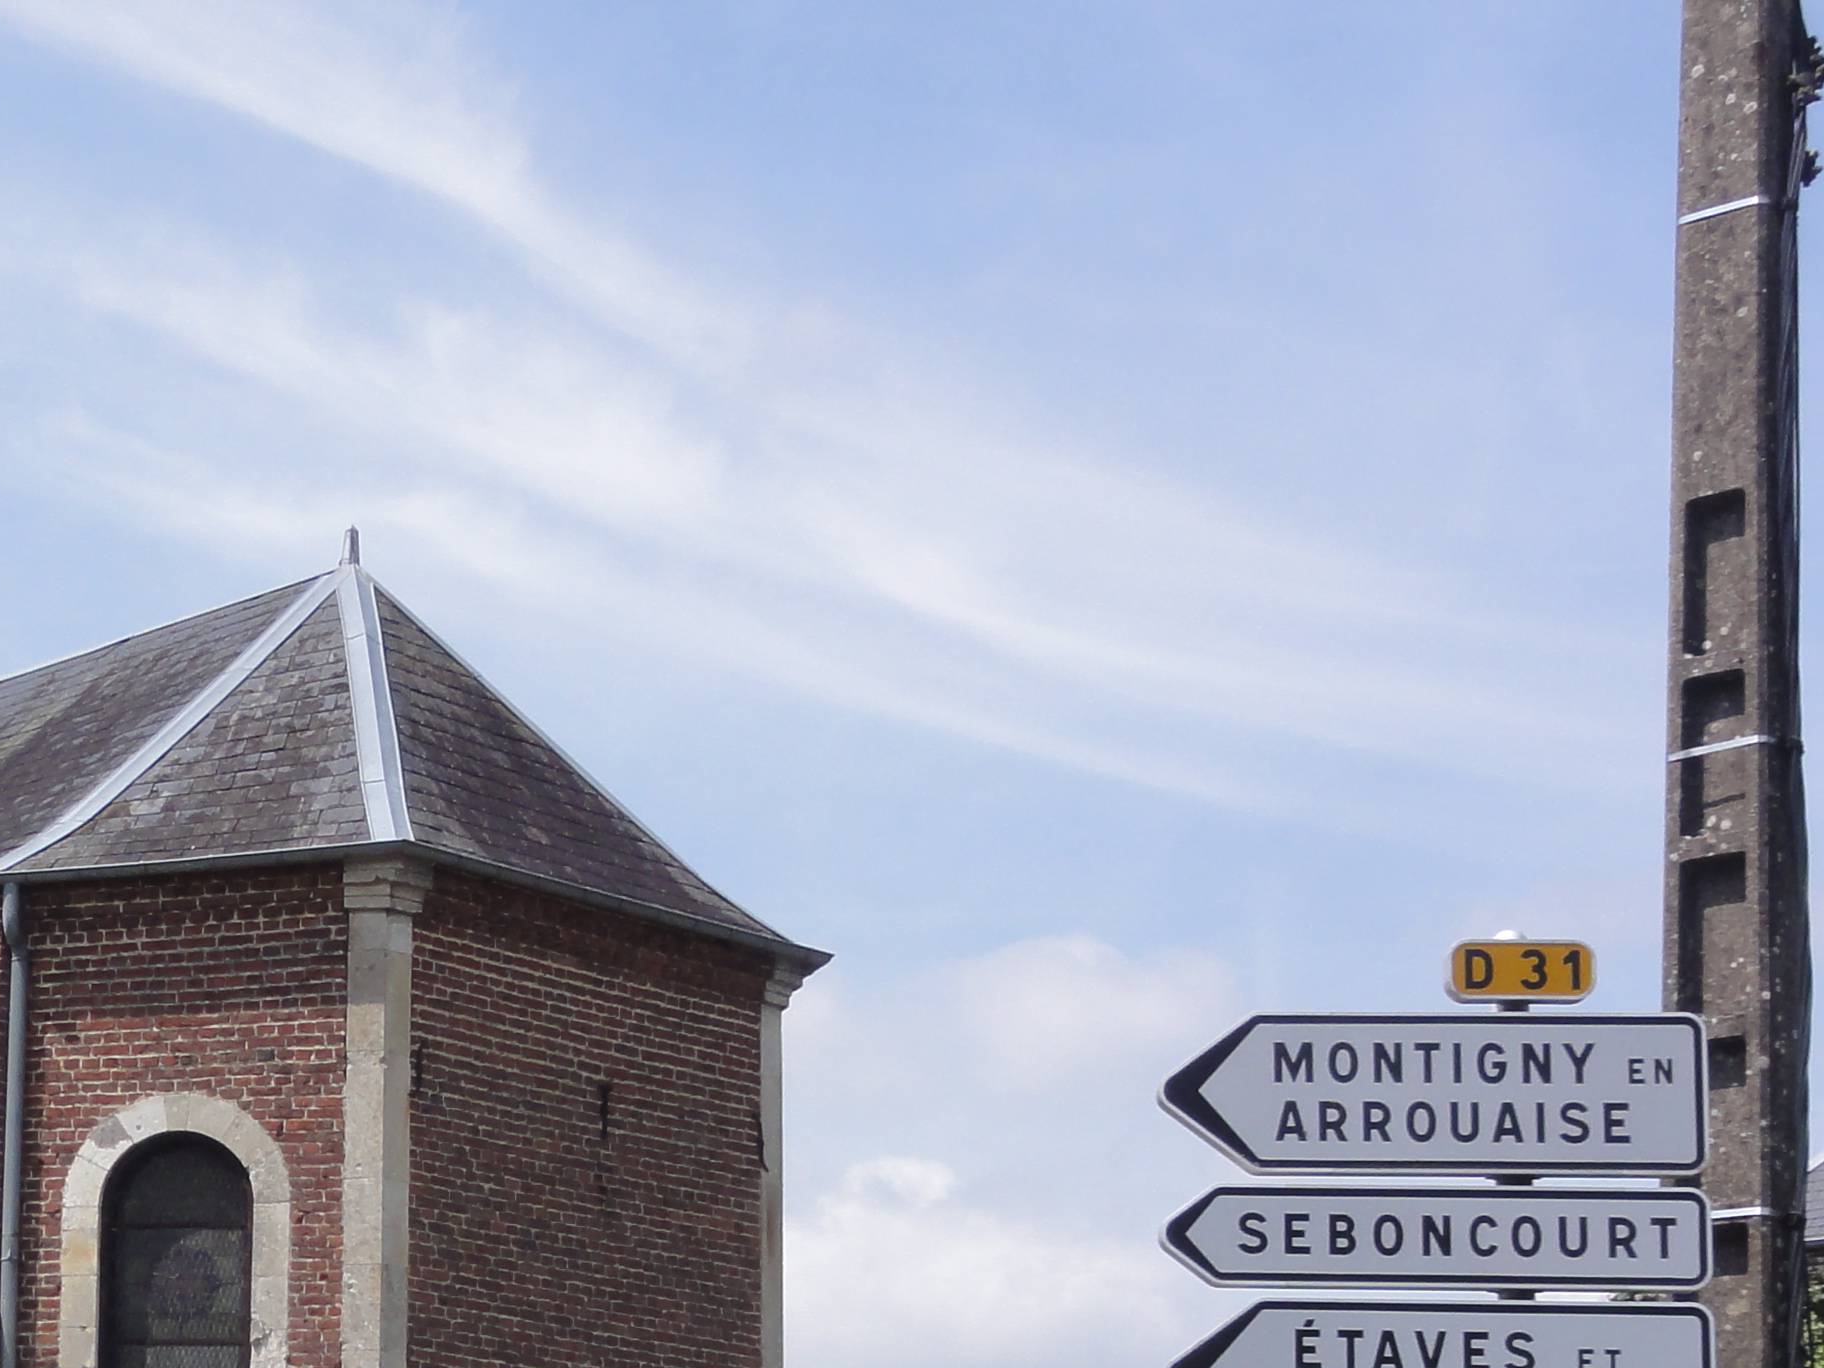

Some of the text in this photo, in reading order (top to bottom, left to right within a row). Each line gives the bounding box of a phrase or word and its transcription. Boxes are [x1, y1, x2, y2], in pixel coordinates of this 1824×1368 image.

[1464, 948, 1581, 991] D 31
[1273, 1041, 1673, 1085] MONTIGNY EN
[1275, 1100, 1631, 1144] ARROUAISE
[1238, 1212, 1677, 1259] SEBONCOURT
